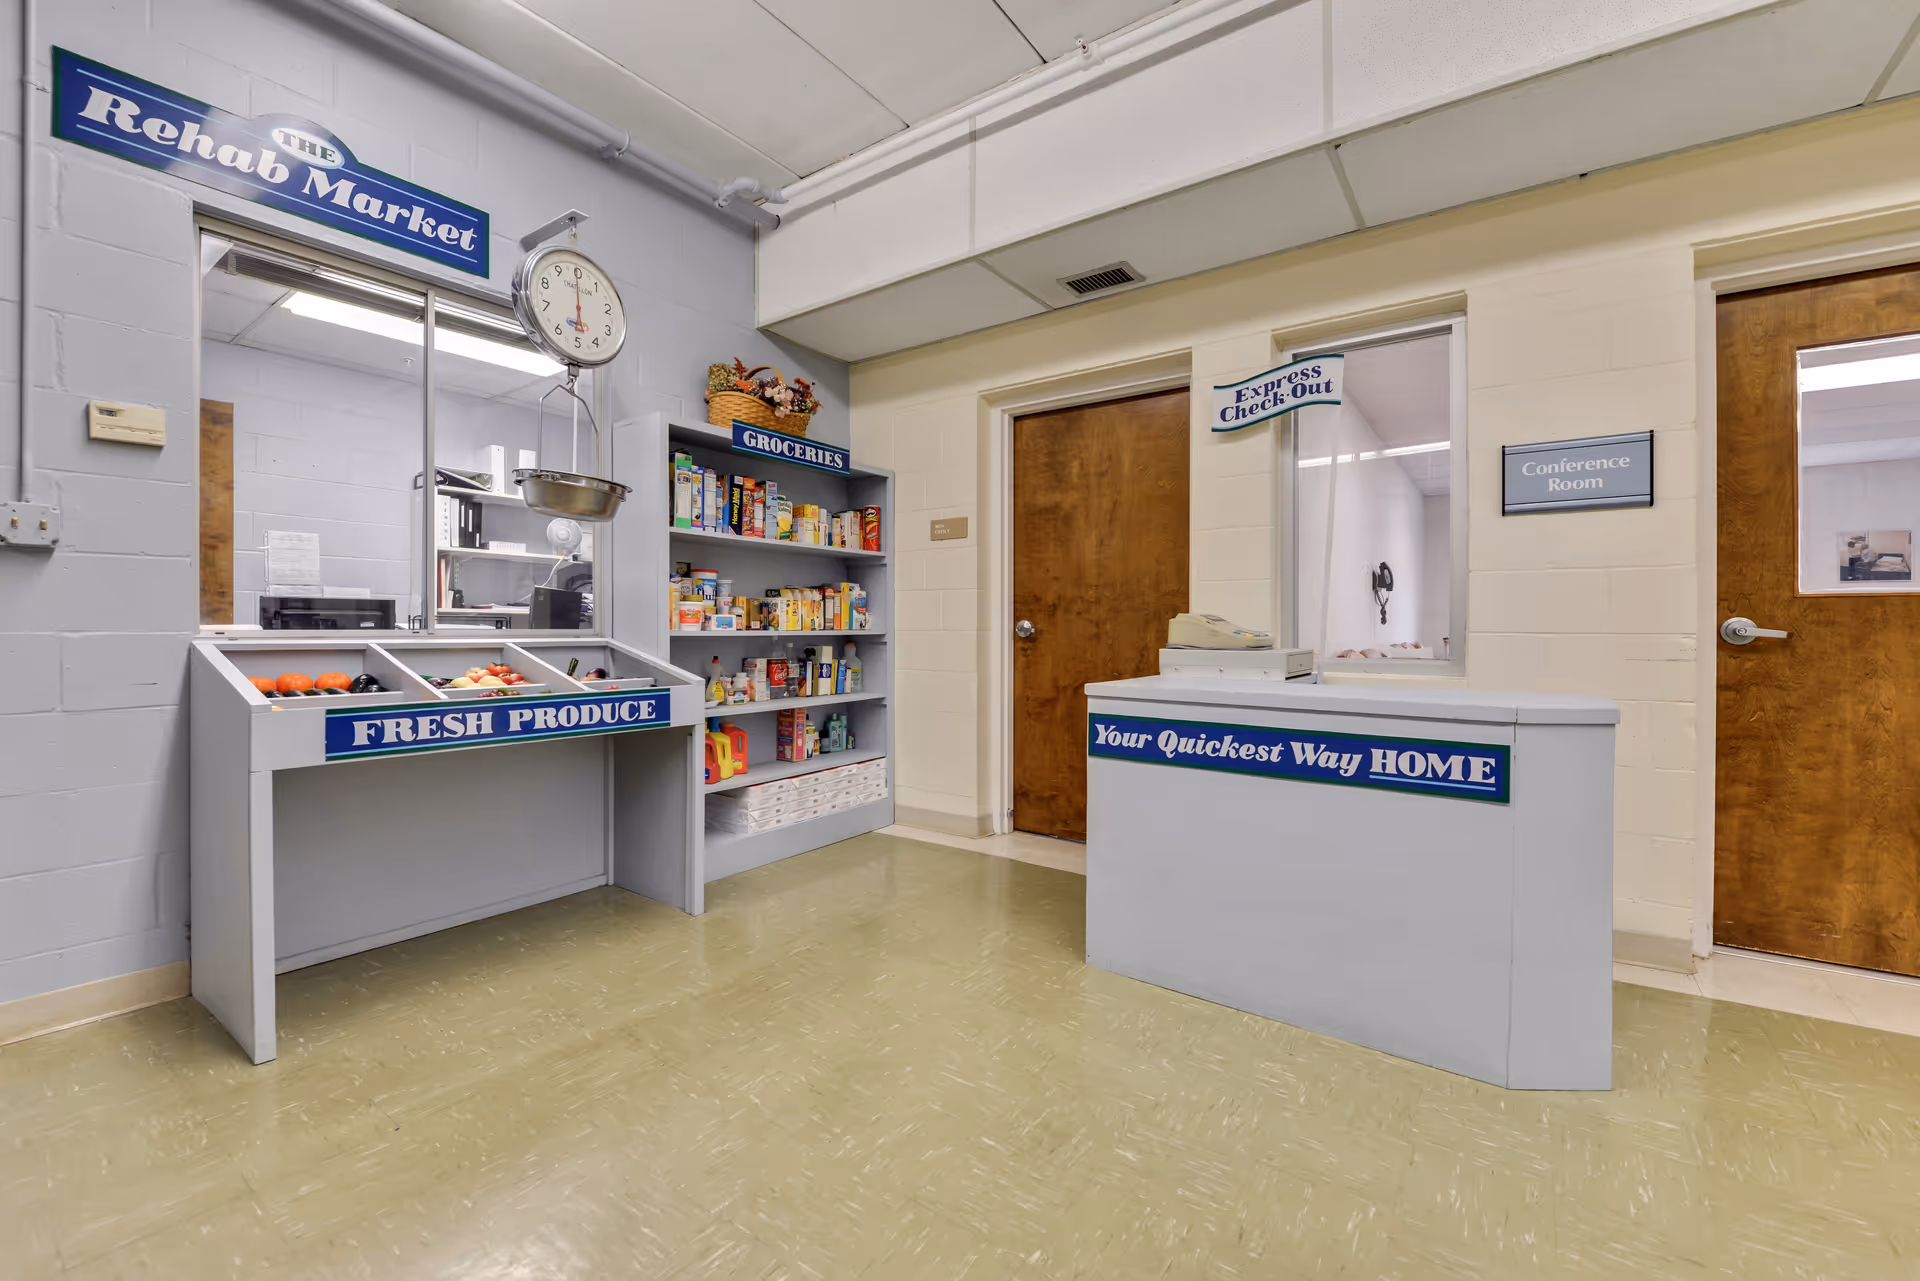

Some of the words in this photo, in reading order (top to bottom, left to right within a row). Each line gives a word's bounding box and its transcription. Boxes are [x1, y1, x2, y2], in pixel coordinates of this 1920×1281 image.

[275, 127, 337, 165] THE
[78, 86, 290, 184] Rehab
[302, 166, 477, 251] Market
[554, 265, 563, 277] 9
[541, 277, 550, 290] 8
[594, 282, 598, 292] 1
[542, 299, 551, 312] 7
[604, 303, 612, 316] 2
[554, 324, 563, 336] 6
[604, 325, 612, 337] 3
[574, 337, 582, 349] 5
[591, 337, 600, 348] 4
[1234, 365, 1322, 404] Express
[743, 430, 843, 469] GROCERIES
[1521, 456, 1631, 476] Conference
[1548, 477, 1604, 492] Room
[731, 506, 739, 525] Honey
[352, 711, 493, 746] FRESH
[508, 700, 656, 732] PRODUCE
[1094, 724, 1153, 750] Your
[1157, 729, 1285, 763] Quickest
[1290, 741, 1363, 777] Way
[1369, 748, 1496, 784] HOME
